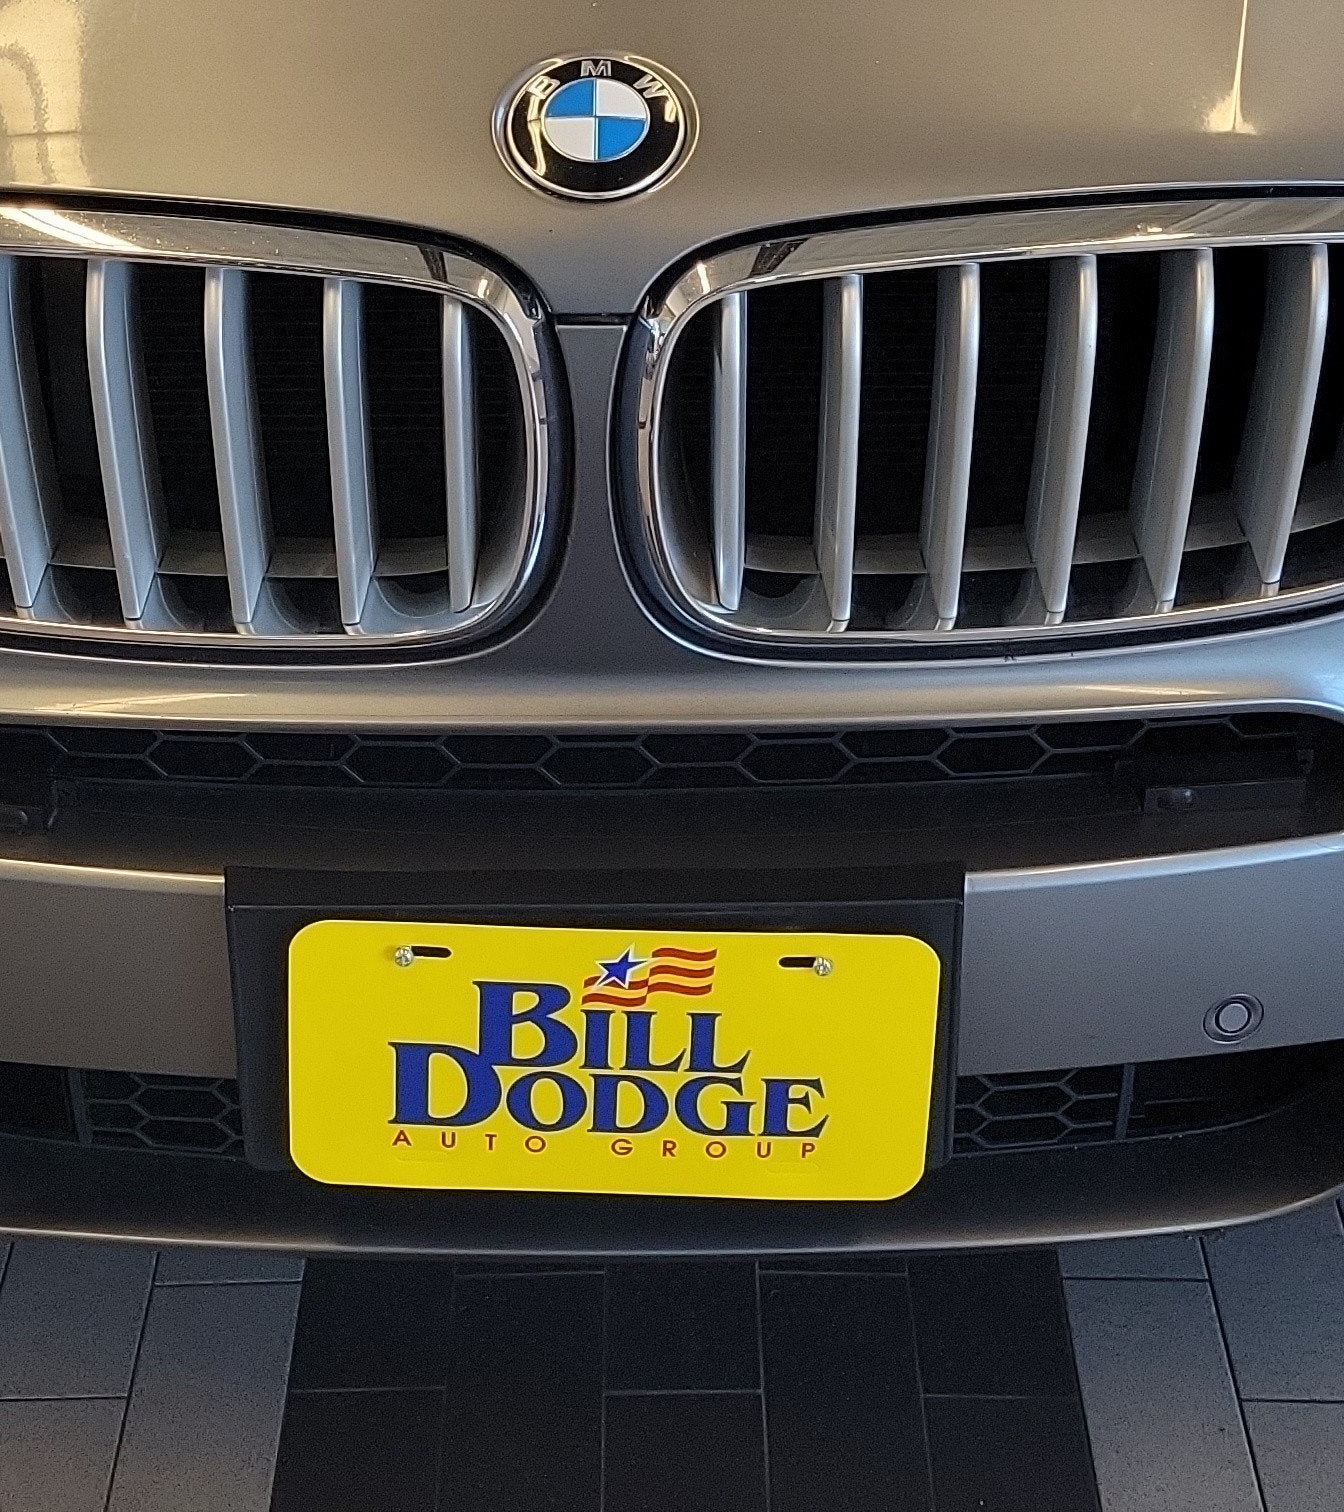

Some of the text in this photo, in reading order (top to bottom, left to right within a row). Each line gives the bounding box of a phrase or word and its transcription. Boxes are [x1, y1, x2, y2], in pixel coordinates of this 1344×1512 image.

[526, 59, 670, 101] BMW
[472, 980, 752, 1074] BILL
[388, 1040, 830, 1138] DODGE
[392, 1129, 818, 1160] AUTO GROUP
